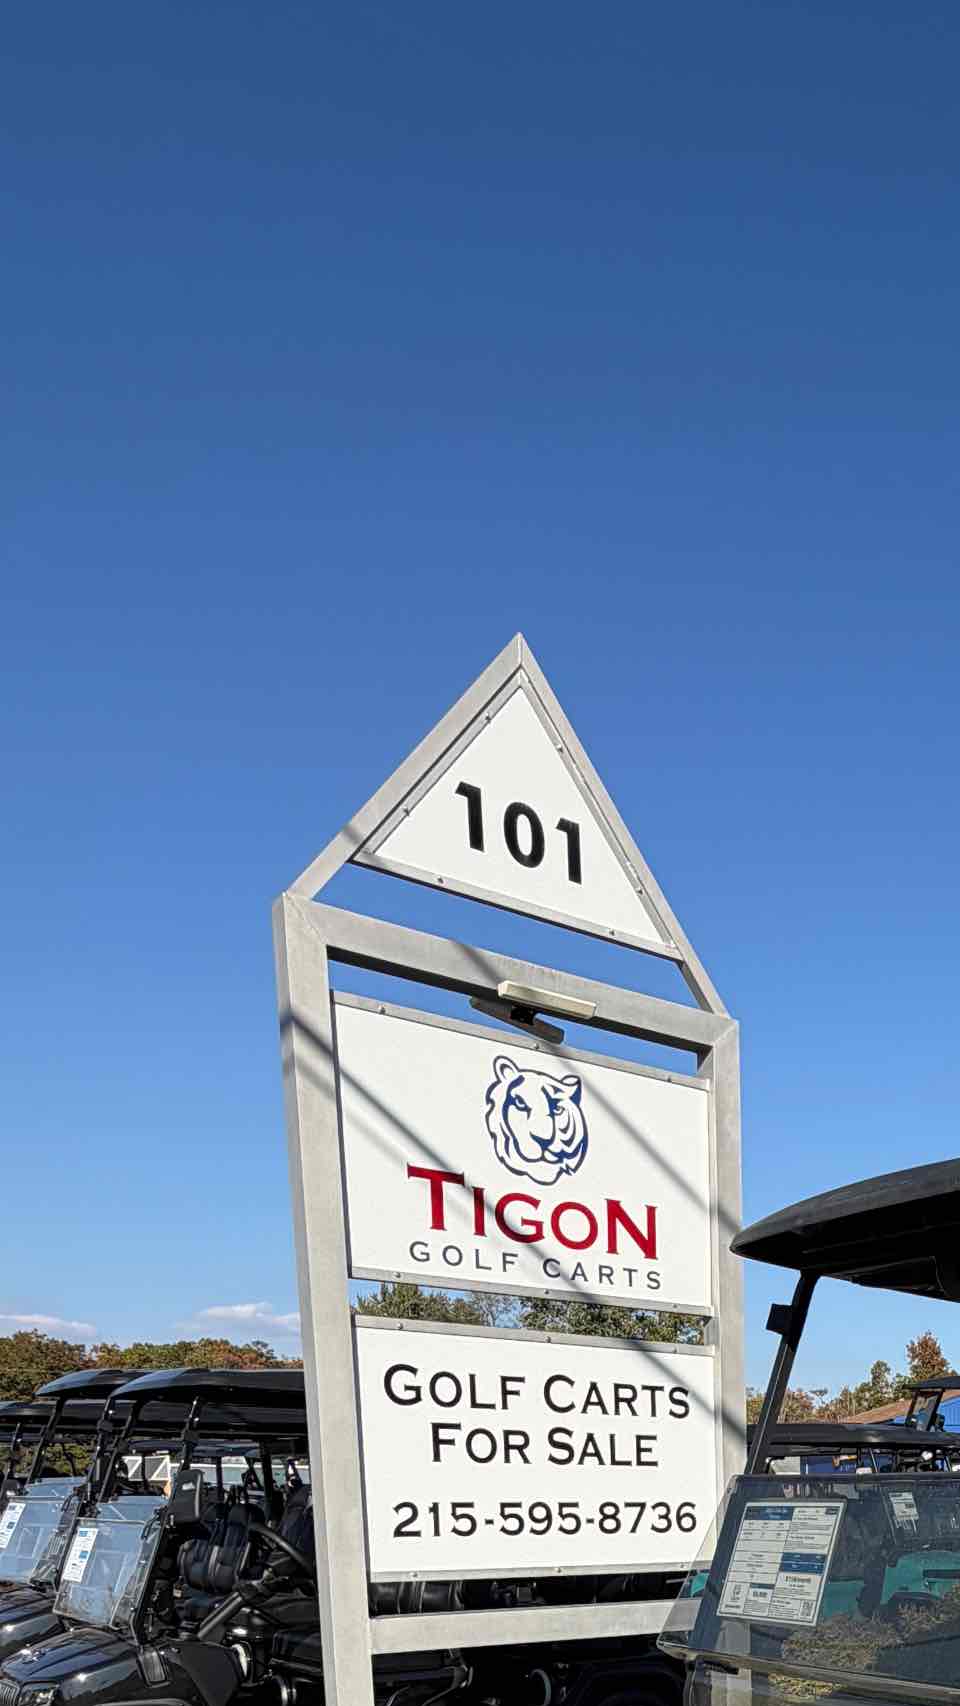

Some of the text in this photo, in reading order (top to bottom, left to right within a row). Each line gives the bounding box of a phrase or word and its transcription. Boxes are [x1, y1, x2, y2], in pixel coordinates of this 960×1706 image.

[455, 781, 582, 884] 101
[406, 1164, 658, 1261] TIGON
[409, 1240, 662, 1291] GOLF CARTS
[383, 1363, 691, 1420] GOLF CARTS
[431, 1422, 658, 1468] FOR SALE
[393, 1501, 697, 1538] 215-595-8736
